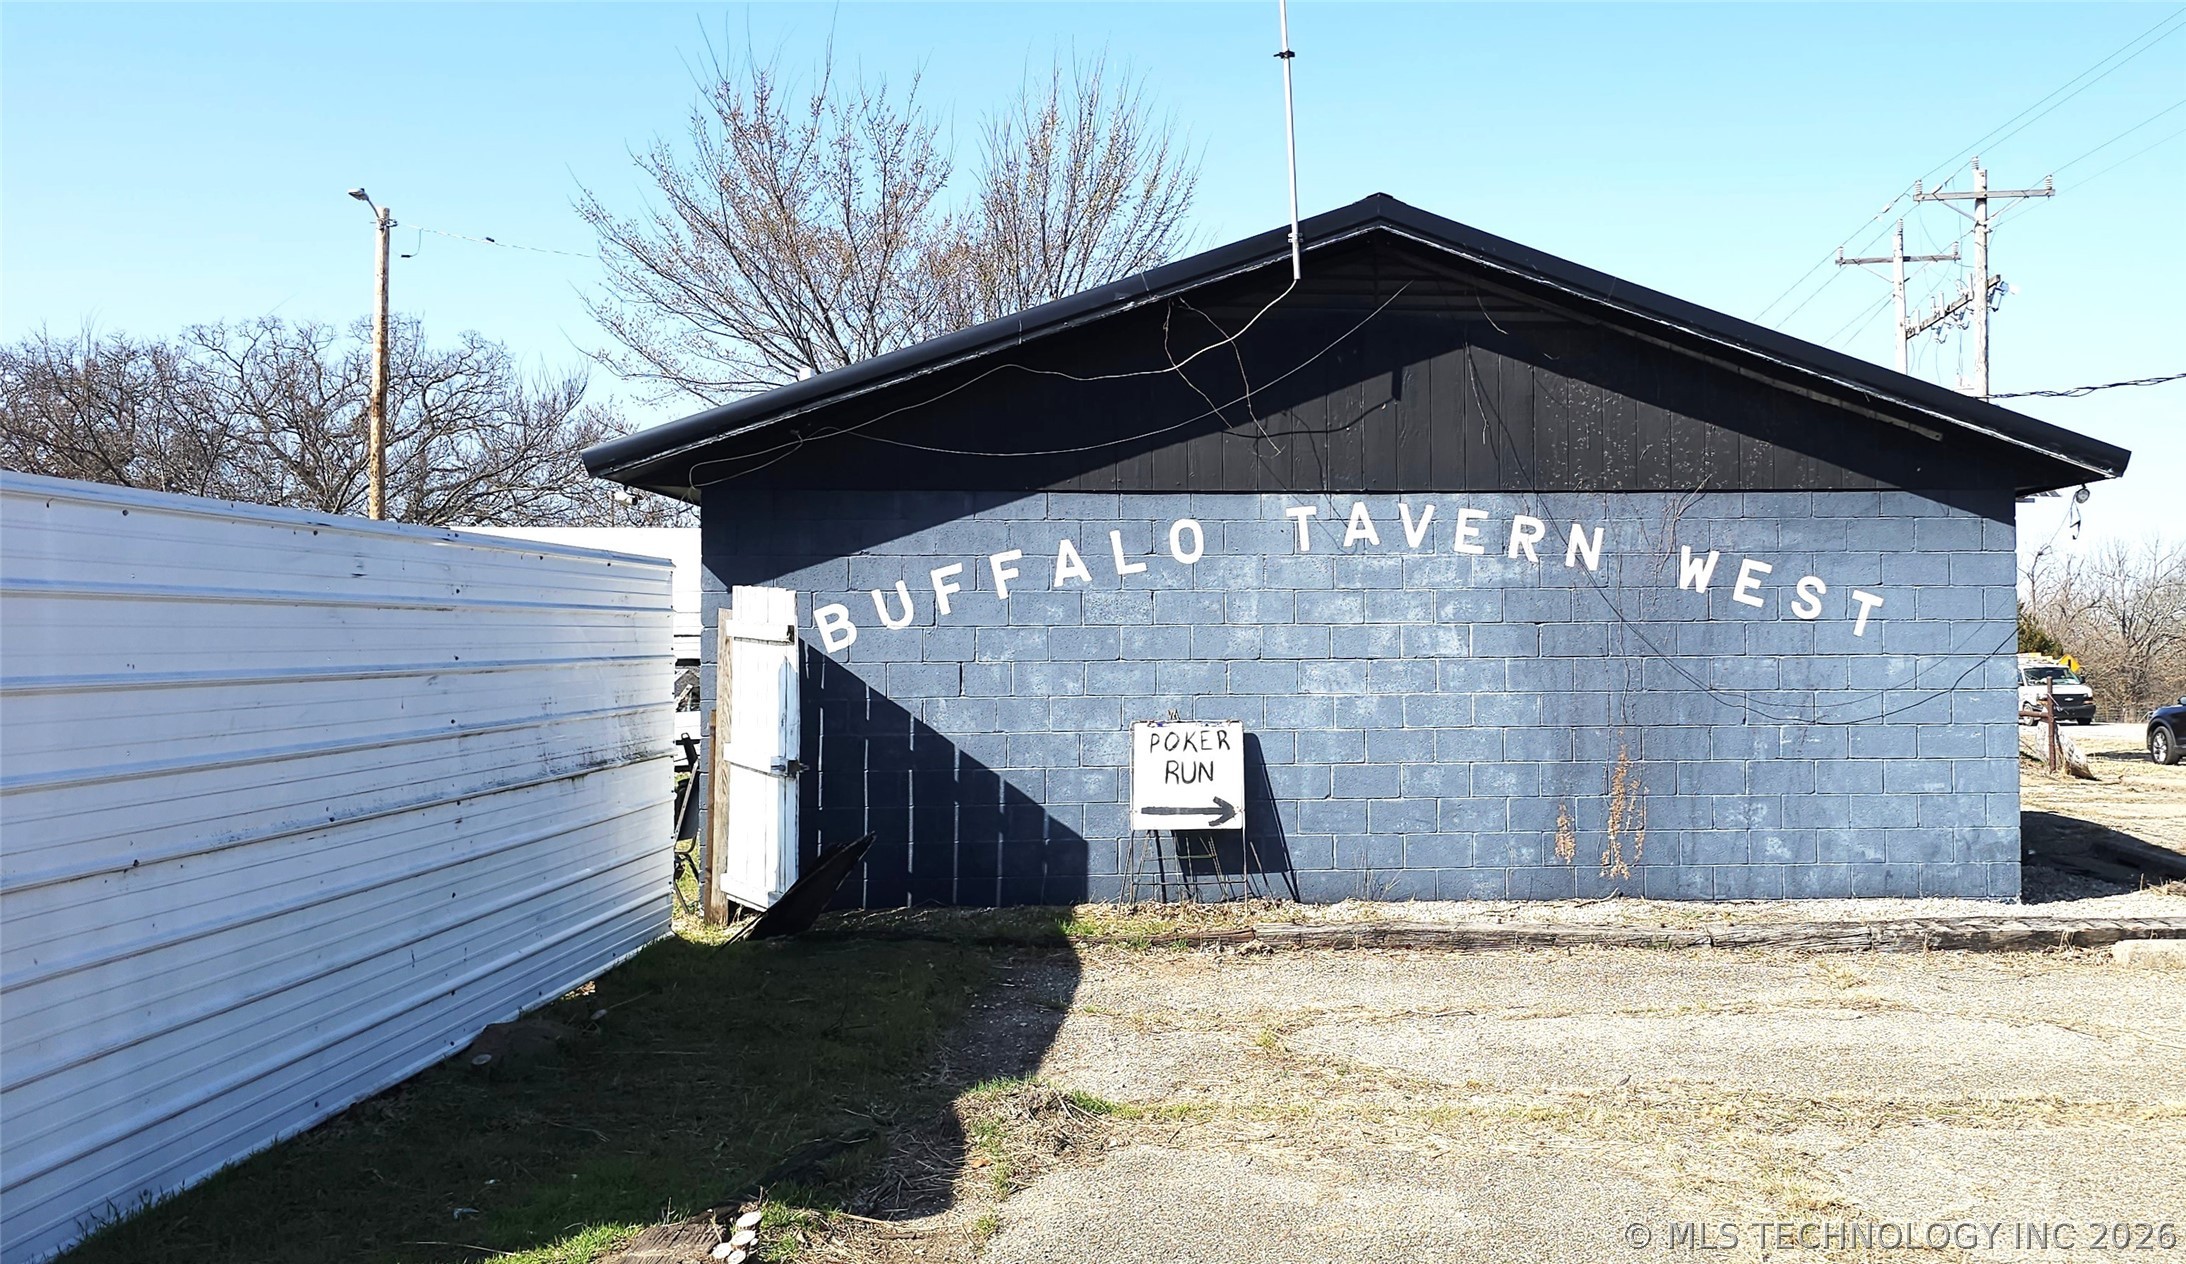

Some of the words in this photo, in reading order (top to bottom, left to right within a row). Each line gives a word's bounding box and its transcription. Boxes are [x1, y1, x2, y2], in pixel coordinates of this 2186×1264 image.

[813, 518, 1204, 654] BUFFALO
[1285, 501, 1606, 572] TAVERN
[1678, 544, 1885, 638] WEST
[1150, 730, 1230, 753] POKER
[1165, 760, 1214, 784] RUN
